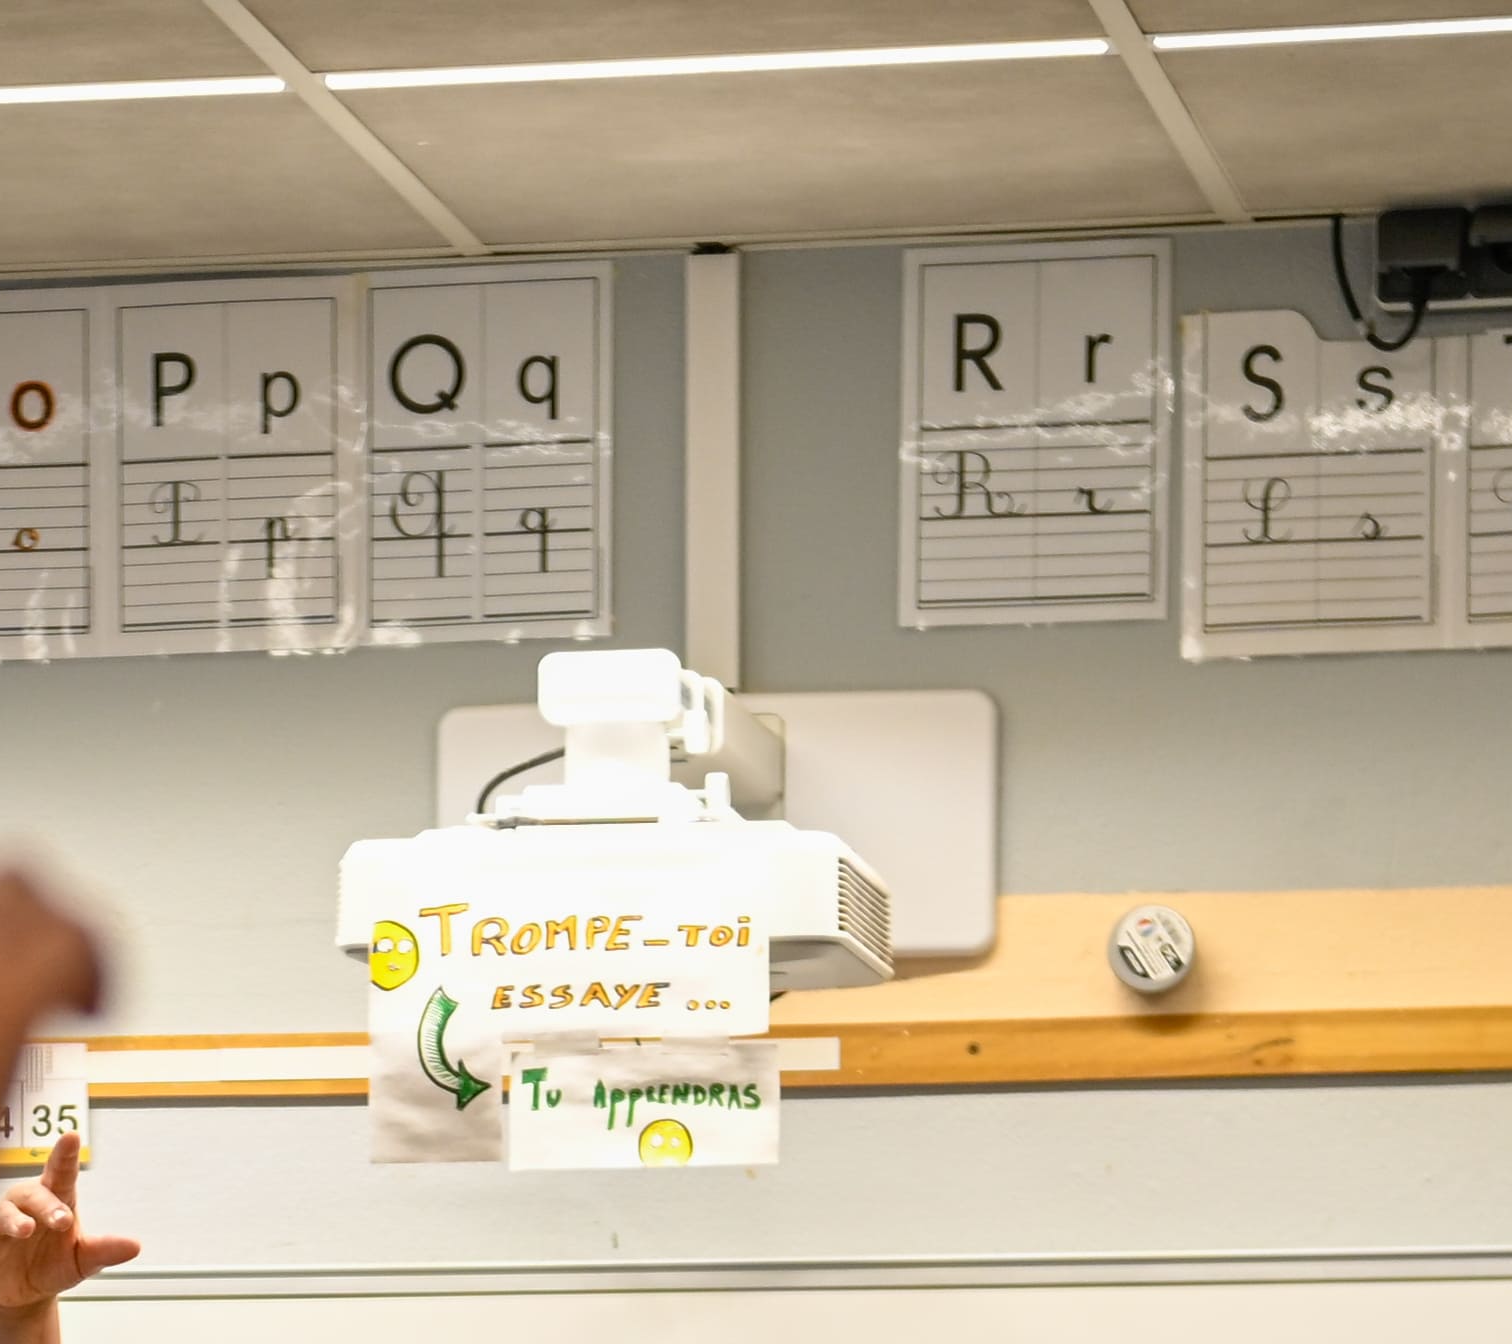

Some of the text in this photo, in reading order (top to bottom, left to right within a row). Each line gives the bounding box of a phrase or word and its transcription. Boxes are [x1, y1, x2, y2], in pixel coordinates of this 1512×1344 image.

[388, 333, 559, 421] Q q
[954, 313, 1112, 393] R r
[1241, 344, 1395, 422] S s
[9, 380, 56, 432] o
[152, 351, 301, 435] P p
[490, 982, 670, 1010] ESSAYE
[31, 1104, 81, 1141] 35
